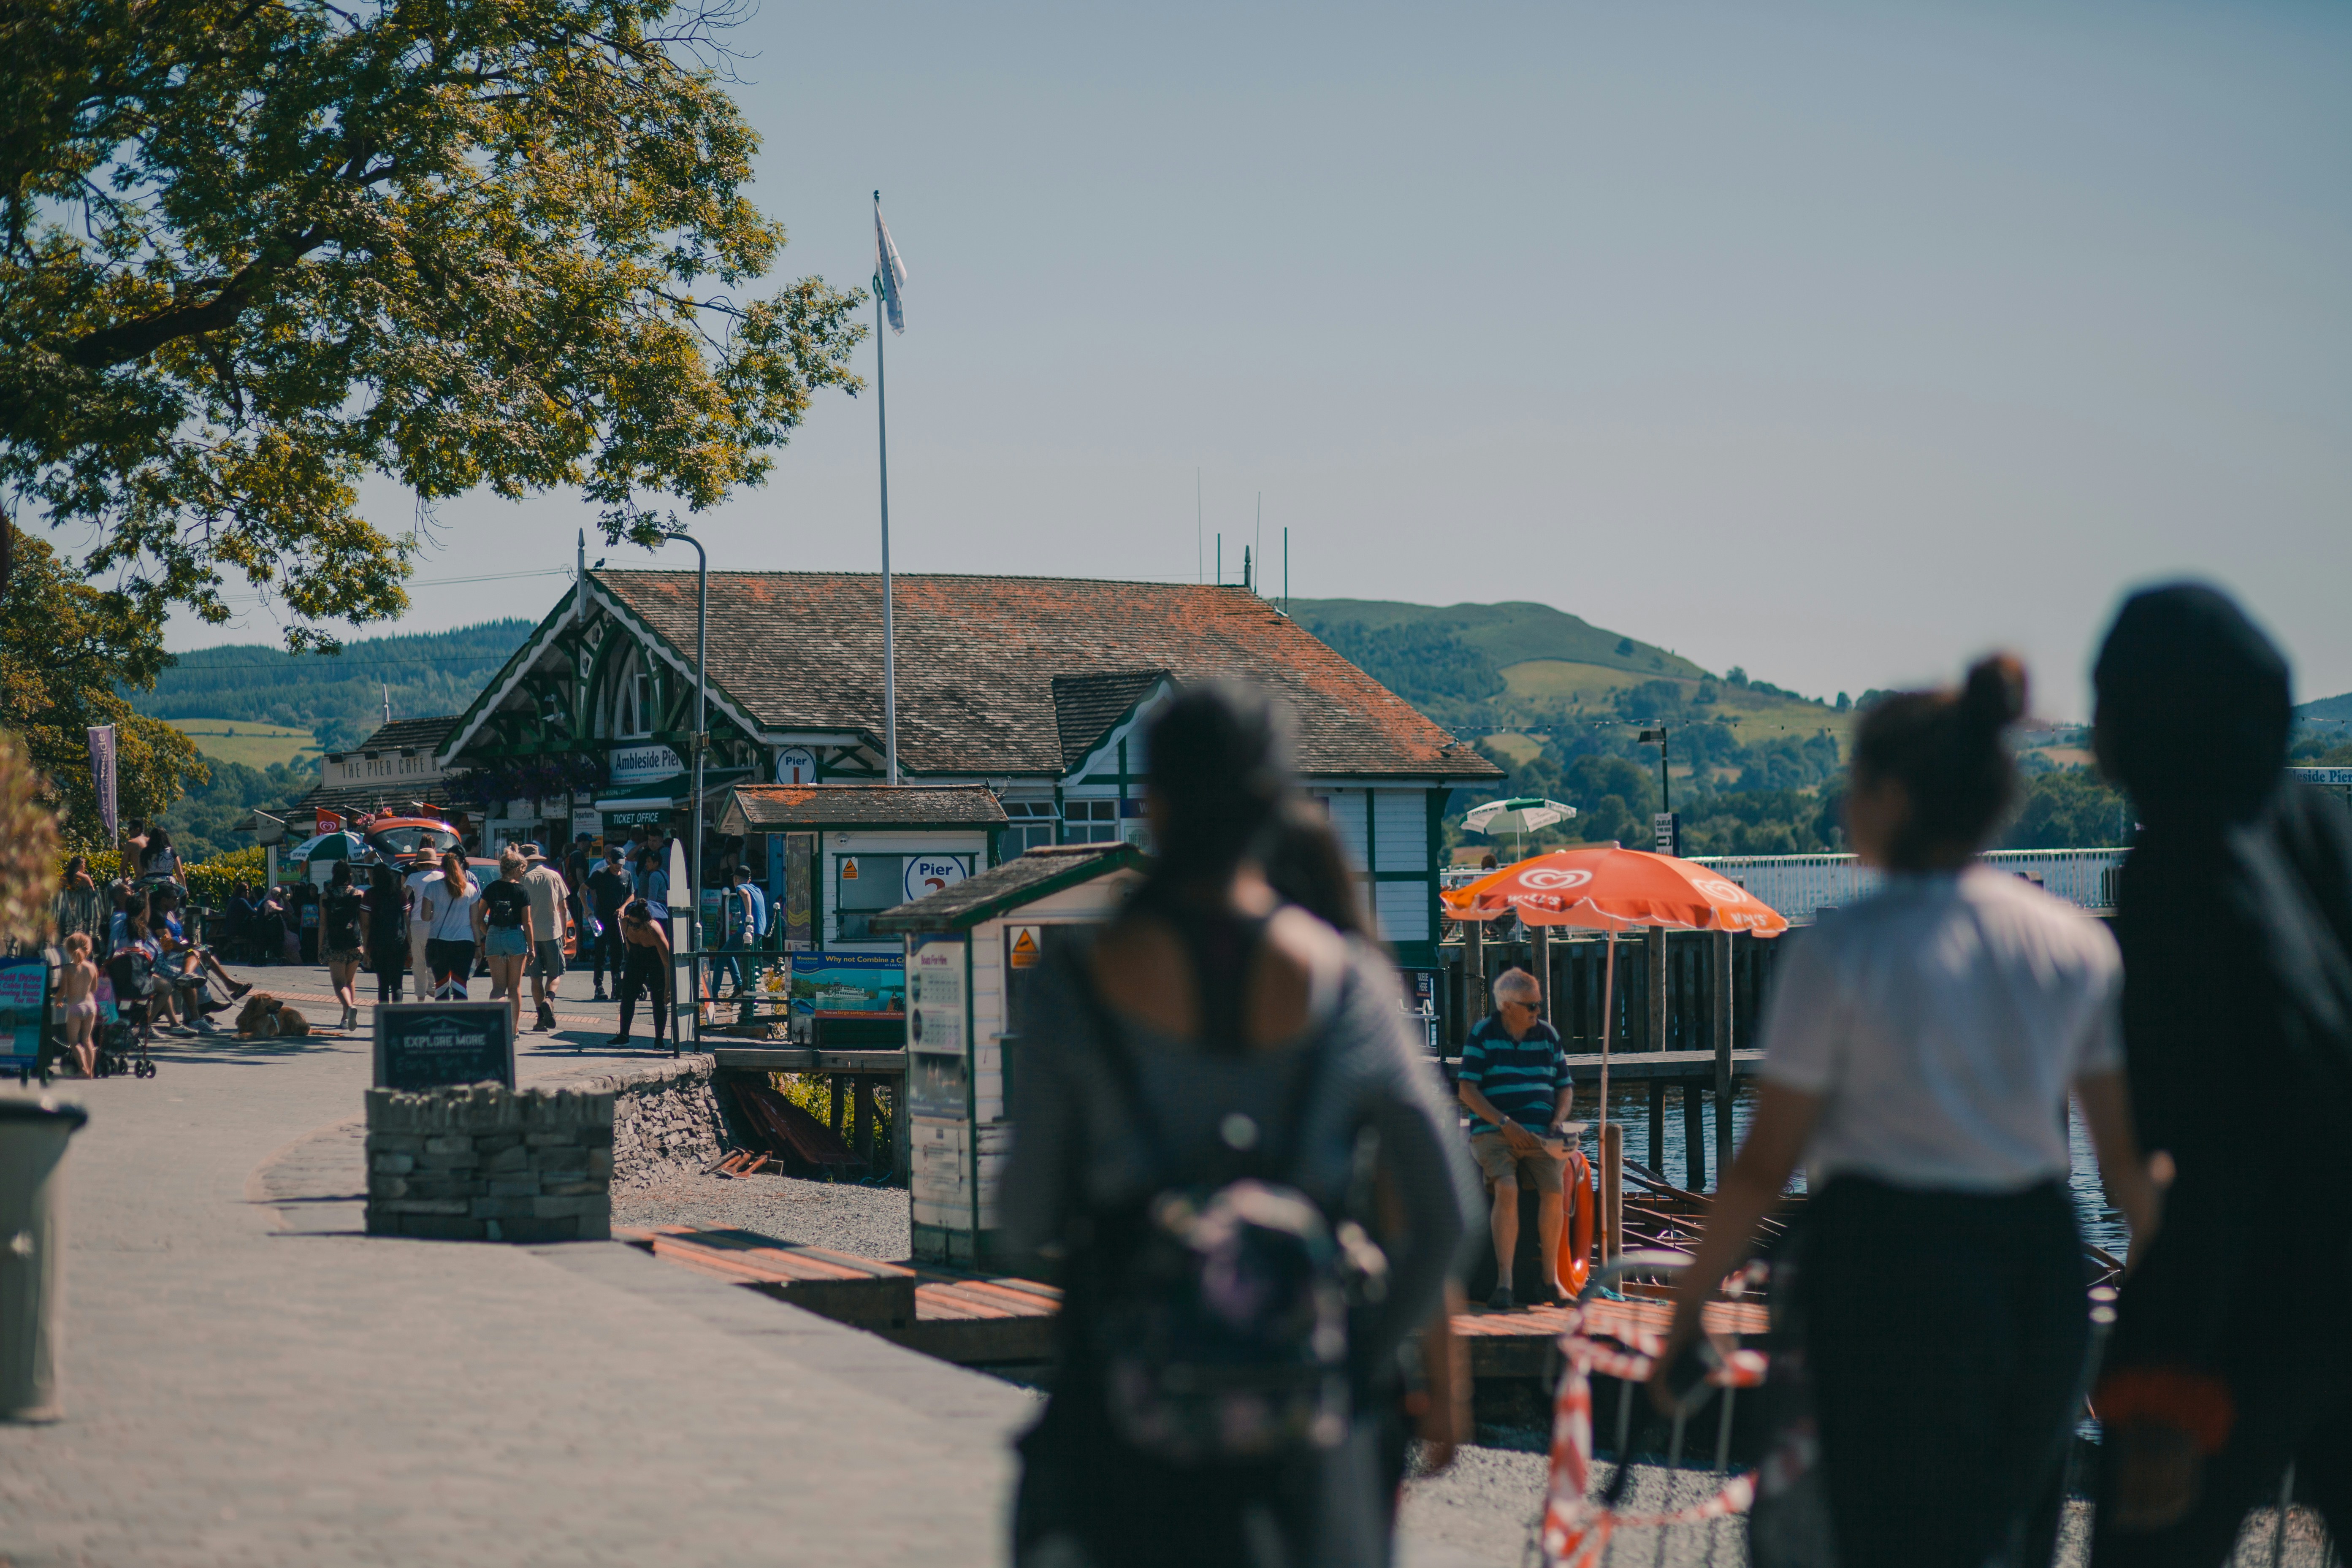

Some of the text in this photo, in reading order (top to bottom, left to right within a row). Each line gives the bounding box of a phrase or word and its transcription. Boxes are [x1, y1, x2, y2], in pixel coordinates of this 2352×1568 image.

[98, 733, 108, 794] Lakeside
[616, 750, 659, 770] Ambleside
[786, 756, 807, 765] Pier
[341, 763, 360, 778] THE
[367, 760, 391, 777] PIER
[399, 755, 424, 774] CAFÉ
[574, 811, 594, 820] Departures
[613, 812, 658, 824] TICKET OFFICE
[1128, 834, 1149, 845] THE PIER
[920, 863, 954, 875] Pier
[1507, 893, 1561, 905] WLL'S
[825, 955, 841, 964] Why
[19, 973, 41, 982] Drive
[1417, 973, 1428, 982] QUEUE
[1419, 982, 1428, 992] HERE
[0, 990, 20, 999] owing
[404, 1034, 486, 1048] EXPLORE MORE
